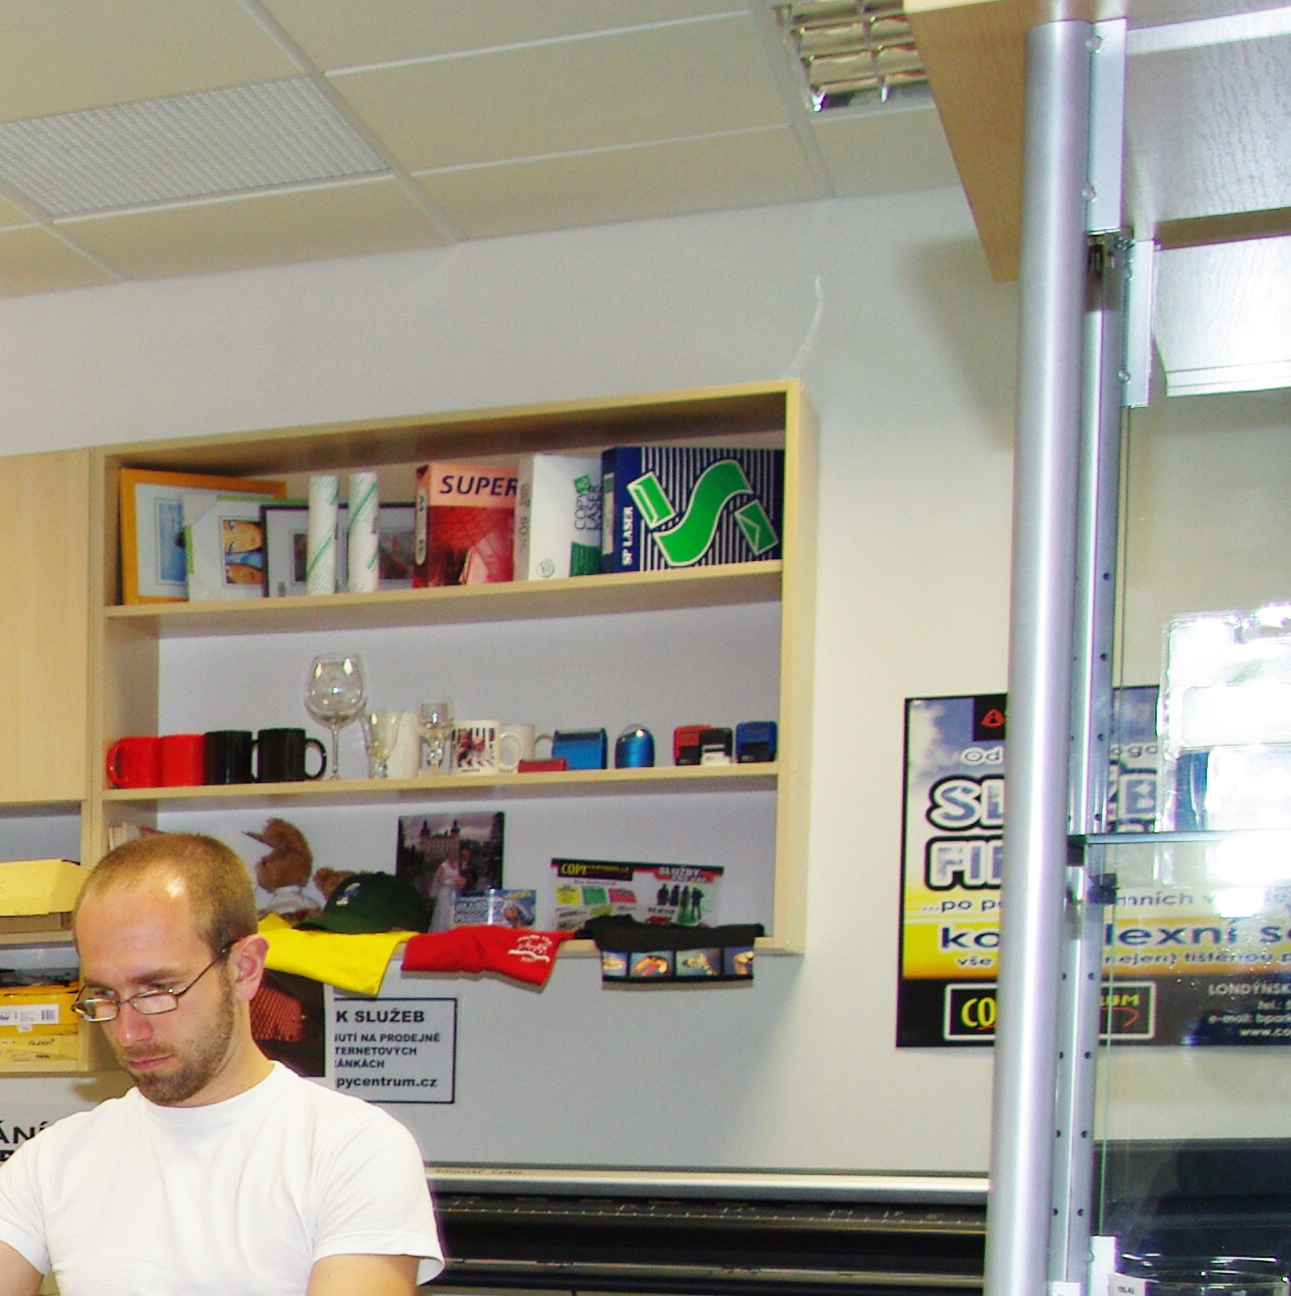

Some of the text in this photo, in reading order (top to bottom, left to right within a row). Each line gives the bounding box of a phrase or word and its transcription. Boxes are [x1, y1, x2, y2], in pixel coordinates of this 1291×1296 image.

[440, 474, 517, 497] SUPER
[622, 506, 634, 545] LASER
[355, 1007, 425, 1023] SLUŽEB
[361, 1034, 376, 1042] NA
[380, 1032, 440, 1043] PRODEJNĚ
[336, 1076, 437, 1089] pycentrum.cz
